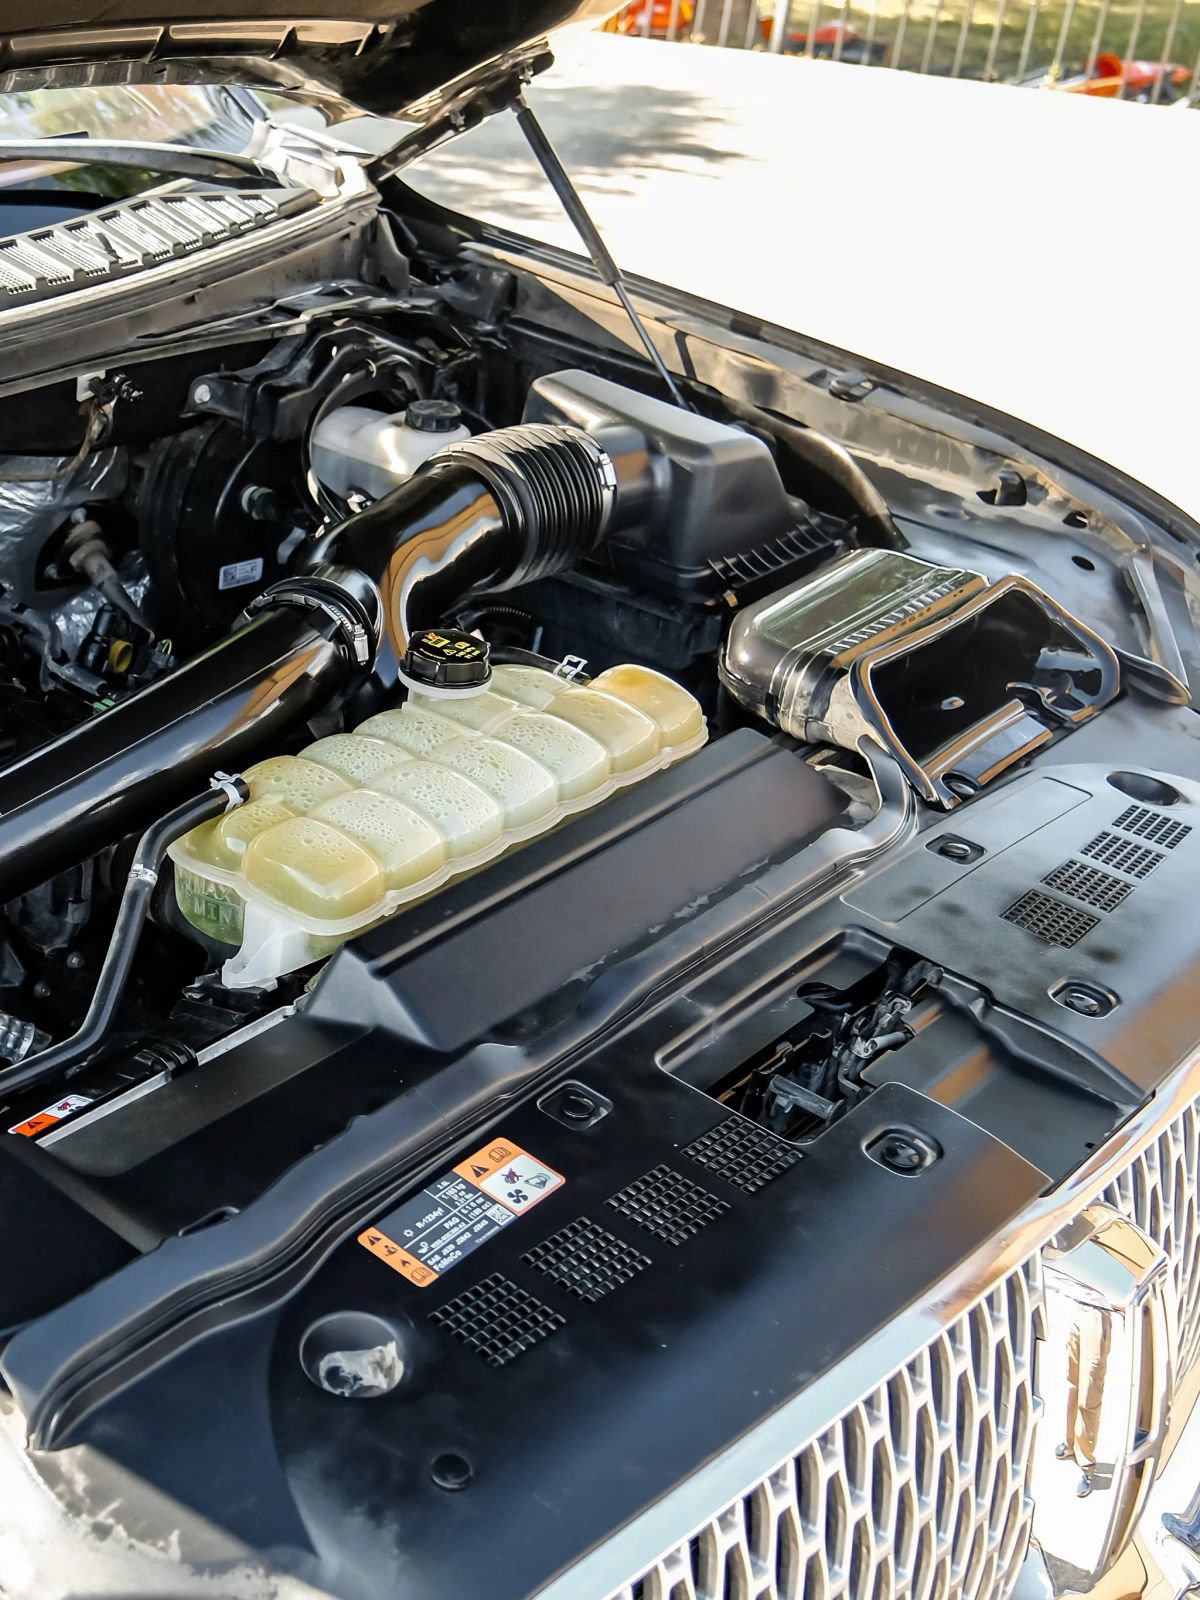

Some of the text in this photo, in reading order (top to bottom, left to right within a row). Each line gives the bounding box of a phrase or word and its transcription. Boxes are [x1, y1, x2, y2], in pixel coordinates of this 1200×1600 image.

[193, 897, 231, 927] MIN
[443, 1217, 460, 1230] PAG
[432, 1250, 462, 1272] FoMoCo
